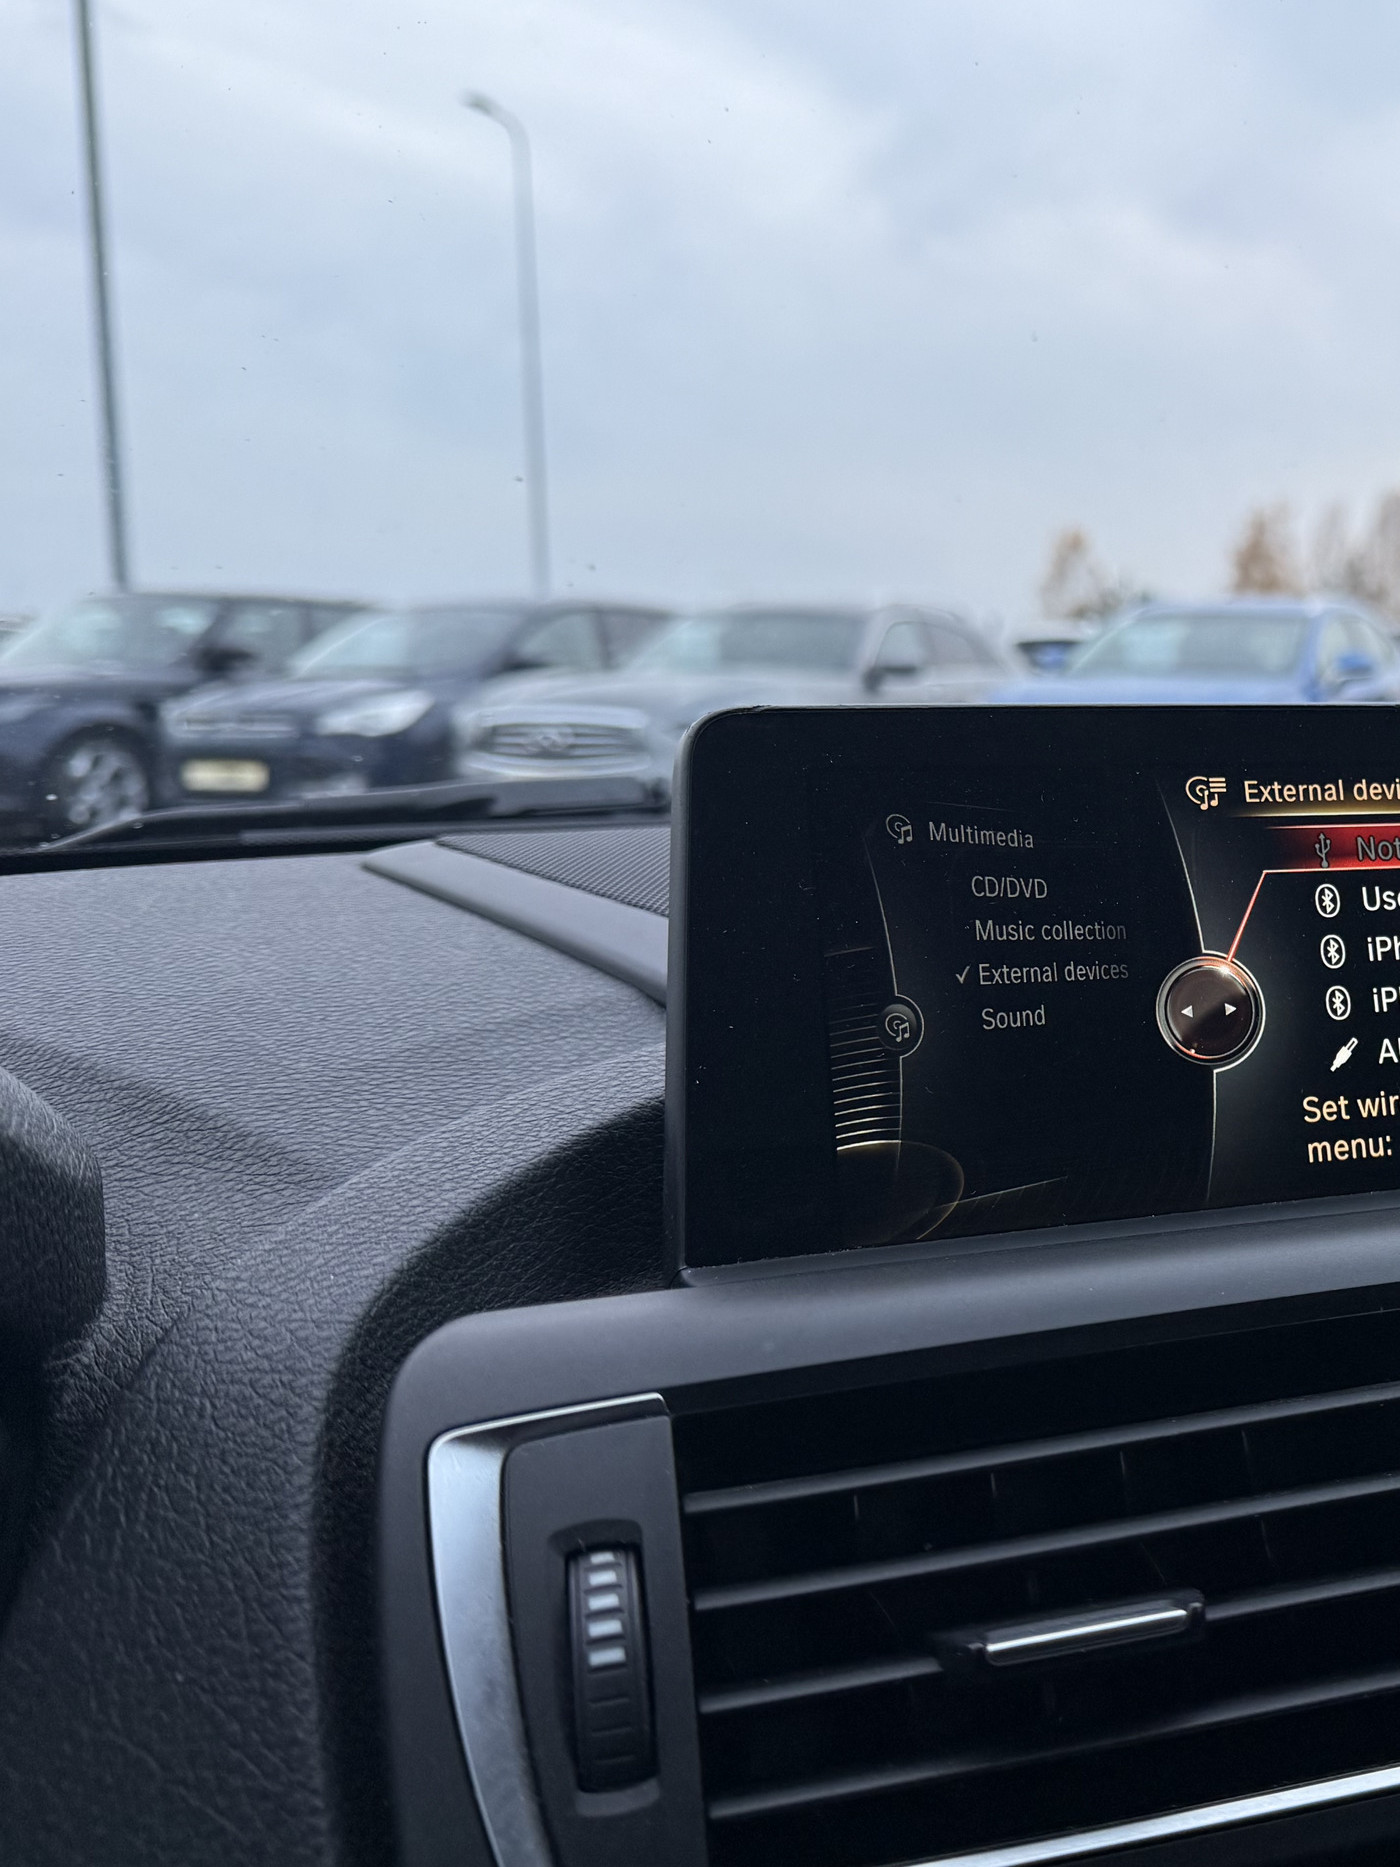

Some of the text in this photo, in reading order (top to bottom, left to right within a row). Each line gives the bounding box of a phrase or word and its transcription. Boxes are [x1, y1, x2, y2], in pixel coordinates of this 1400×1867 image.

[1244, 779, 1344, 803] External
[928, 821, 1034, 849] Multimedia
[971, 875, 1048, 900] CD/DVD
[975, 919, 1127, 942] Music collection
[979, 959, 1130, 986] External devices
[982, 1005, 1046, 1031] Sound
[1302, 1094, 1350, 1124] Set
[1307, 1134, 1393, 1164] menu:
